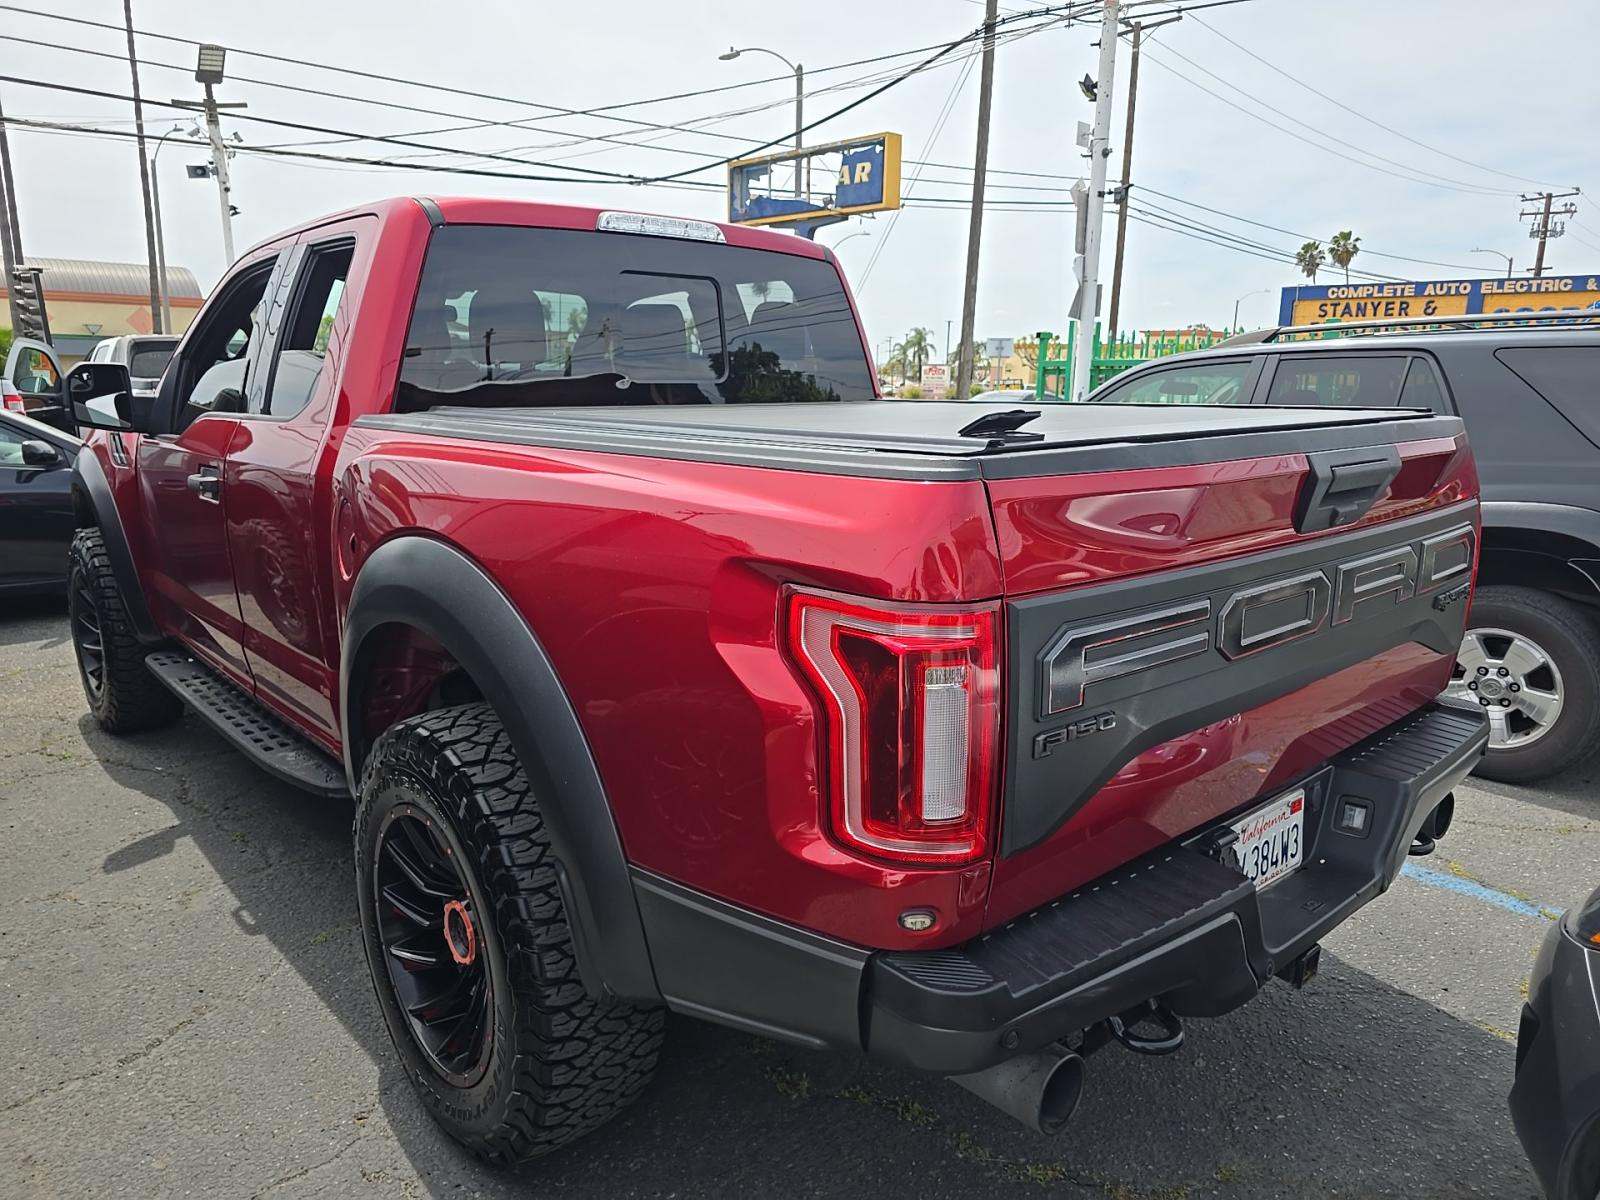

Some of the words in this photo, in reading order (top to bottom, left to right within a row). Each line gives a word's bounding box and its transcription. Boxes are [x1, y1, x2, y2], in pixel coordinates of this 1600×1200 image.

[1327, 284, 1415, 299] COMPLETE
[1424, 282, 1472, 296] AUTO
[1480, 278, 1573, 294] ELECTRIC
[1586, 278, 1598, 290] &
[1318, 301, 1410, 318] STANYER
[1424, 300, 1437, 316] &
[1036, 521, 1476, 721] FORD
[1241, 811, 1290, 844] California
